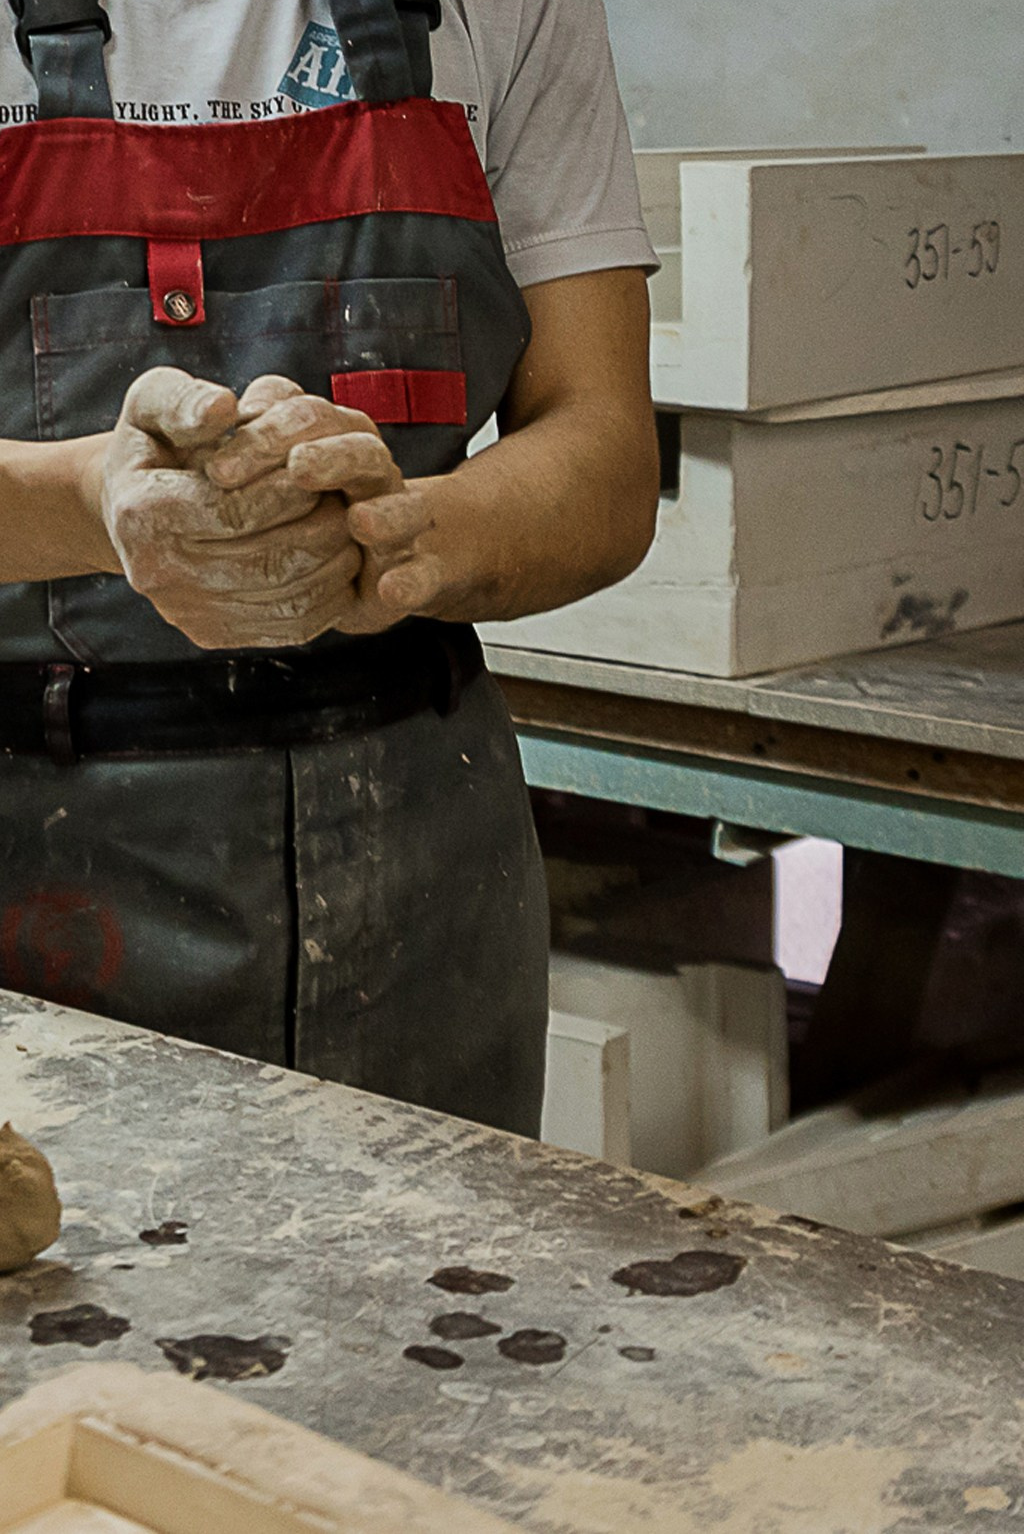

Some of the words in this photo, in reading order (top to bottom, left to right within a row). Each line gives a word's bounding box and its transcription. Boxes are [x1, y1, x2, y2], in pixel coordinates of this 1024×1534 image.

[287, 41, 358, 100] AI
[207, 100, 243, 120] THE
[250, 95, 285, 121] SKY
[905, 220, 1001, 290] 351-59
[922, 439, 1024, 522] 351-5
